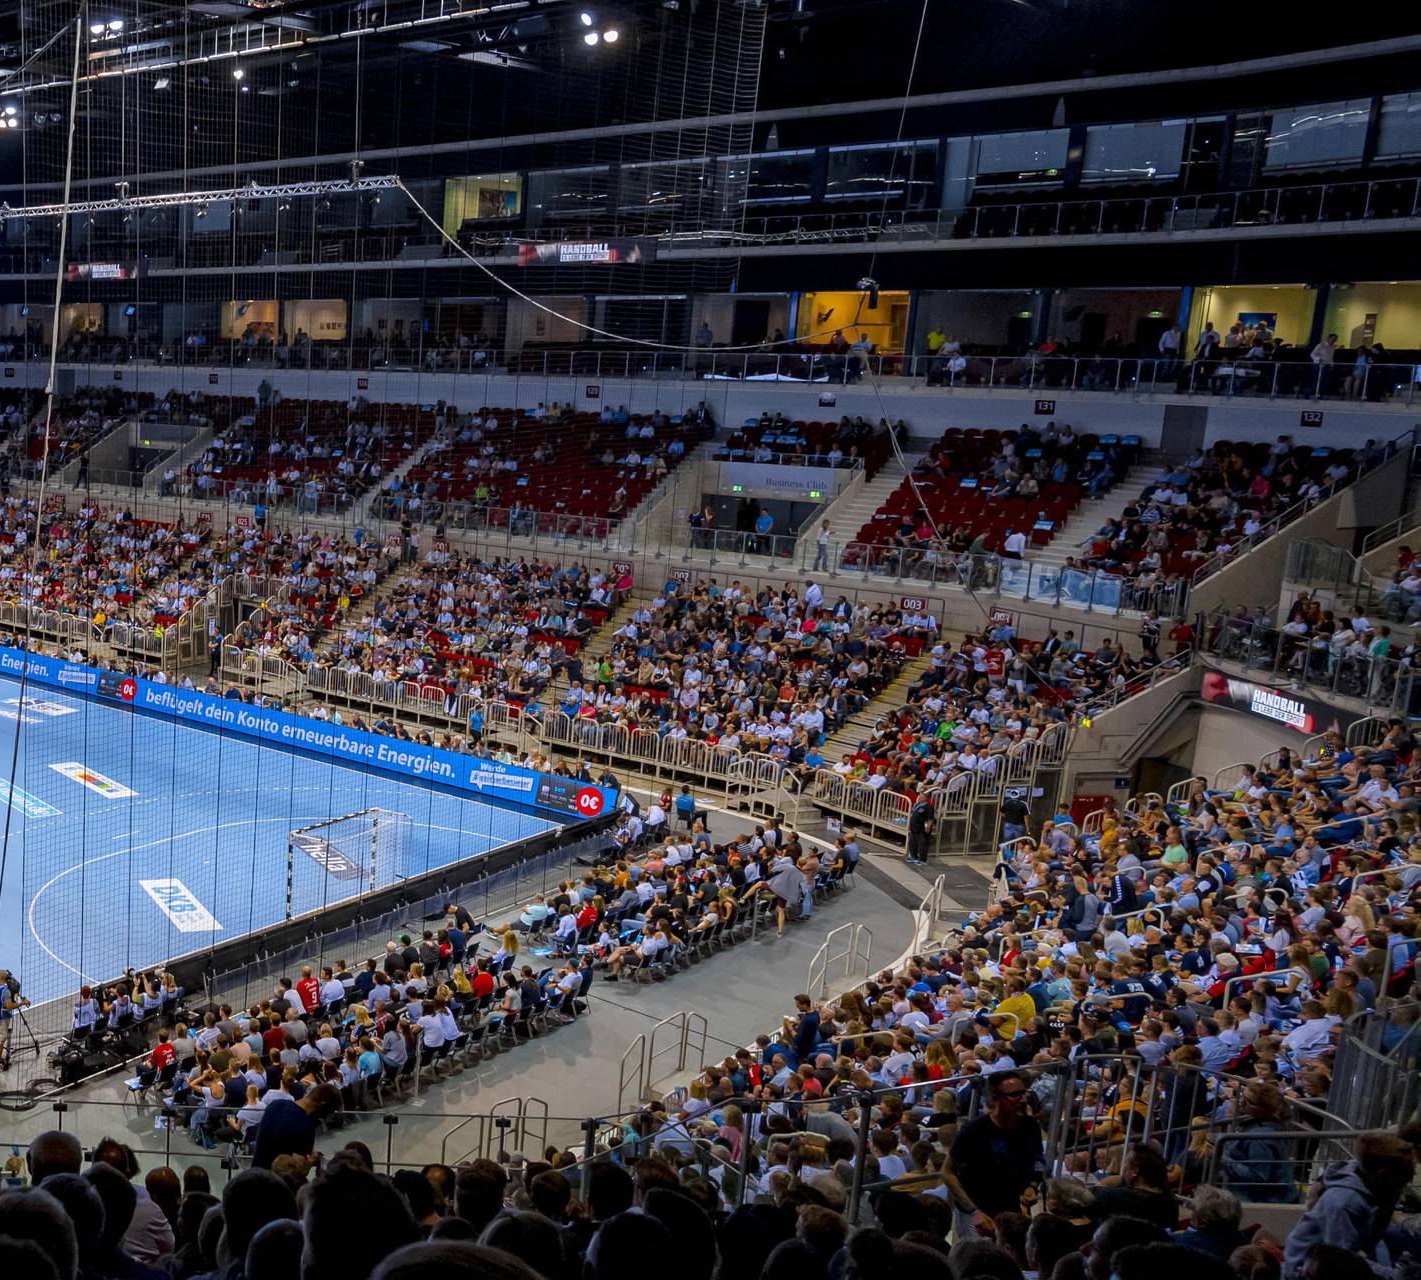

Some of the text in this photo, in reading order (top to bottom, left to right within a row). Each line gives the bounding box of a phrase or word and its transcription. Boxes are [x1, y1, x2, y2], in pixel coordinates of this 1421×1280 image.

[560, 243, 609, 254] HANDBALL
[1038, 401, 1054, 410] 131
[1303, 411, 1321, 422] 132
[766, 477, 827, 490] Business Club
[903, 599, 922, 610] 003
[1252, 689, 1306, 718] HANDBALL
[1286, 711, 1305, 727] SPORT
[146, 688, 455, 778] beflügelt dein Konto erneuerbare Energien.
[480, 762, 507, 774] Werde
[580, 794, 599, 810] 0€
[299, 844, 347, 871] hella
[151, 886, 198, 912] DKB
